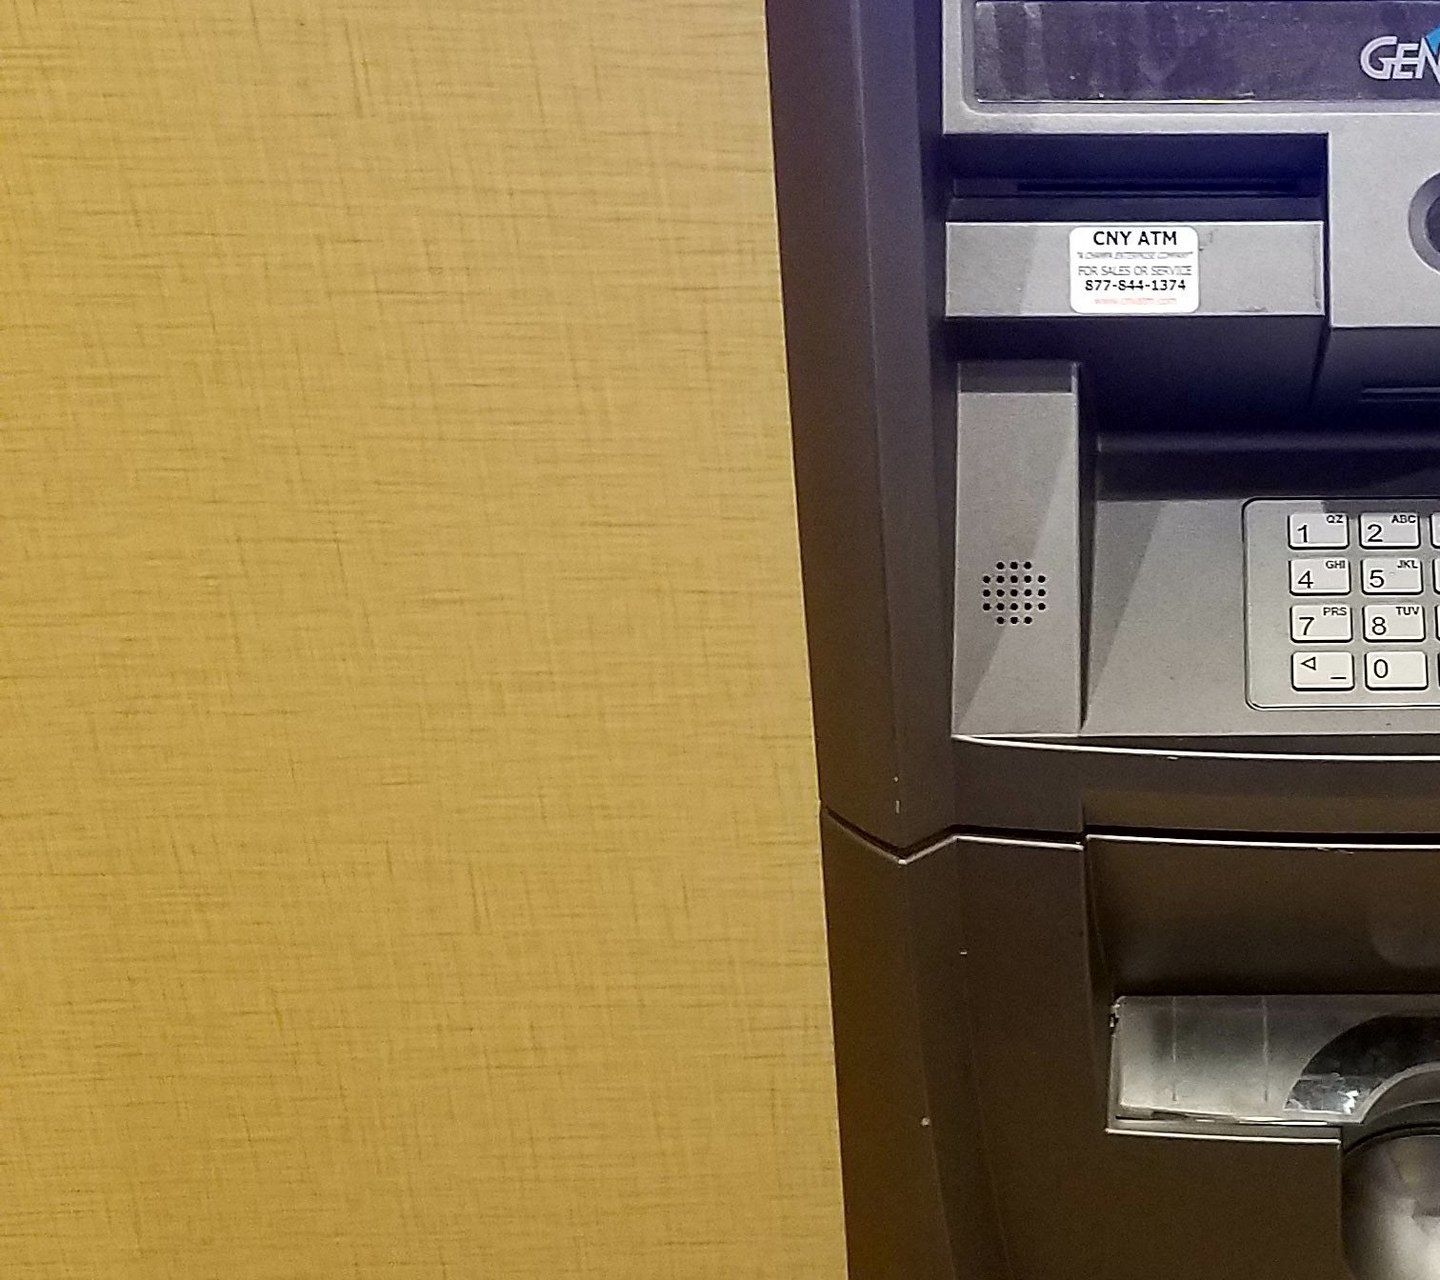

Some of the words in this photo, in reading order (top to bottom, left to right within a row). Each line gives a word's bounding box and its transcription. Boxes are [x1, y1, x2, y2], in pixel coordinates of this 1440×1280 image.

[1093, 230, 1132, 246] CNY
[1138, 230, 1177, 246] ATM
[1085, 279, 1187, 291] 877-844-1374
[1326, 514, 1344, 524] QZ
[1391, 514, 1417, 524] ABC
[1297, 524, 1309, 543] 1
[1367, 524, 1382, 543] 2
[1325, 560, 1346, 570] GHI
[1397, 559, 1418, 569] JKL
[1297, 570, 1314, 589] 4
[1369, 570, 1384, 588] 5
[1323, 607, 1347, 617] PRS
[1396, 606, 1420, 616] TUV
[1298, 617, 1314, 636] 7
[1372, 617, 1387, 635] 8
[1373, 659, 1388, 678] 0
